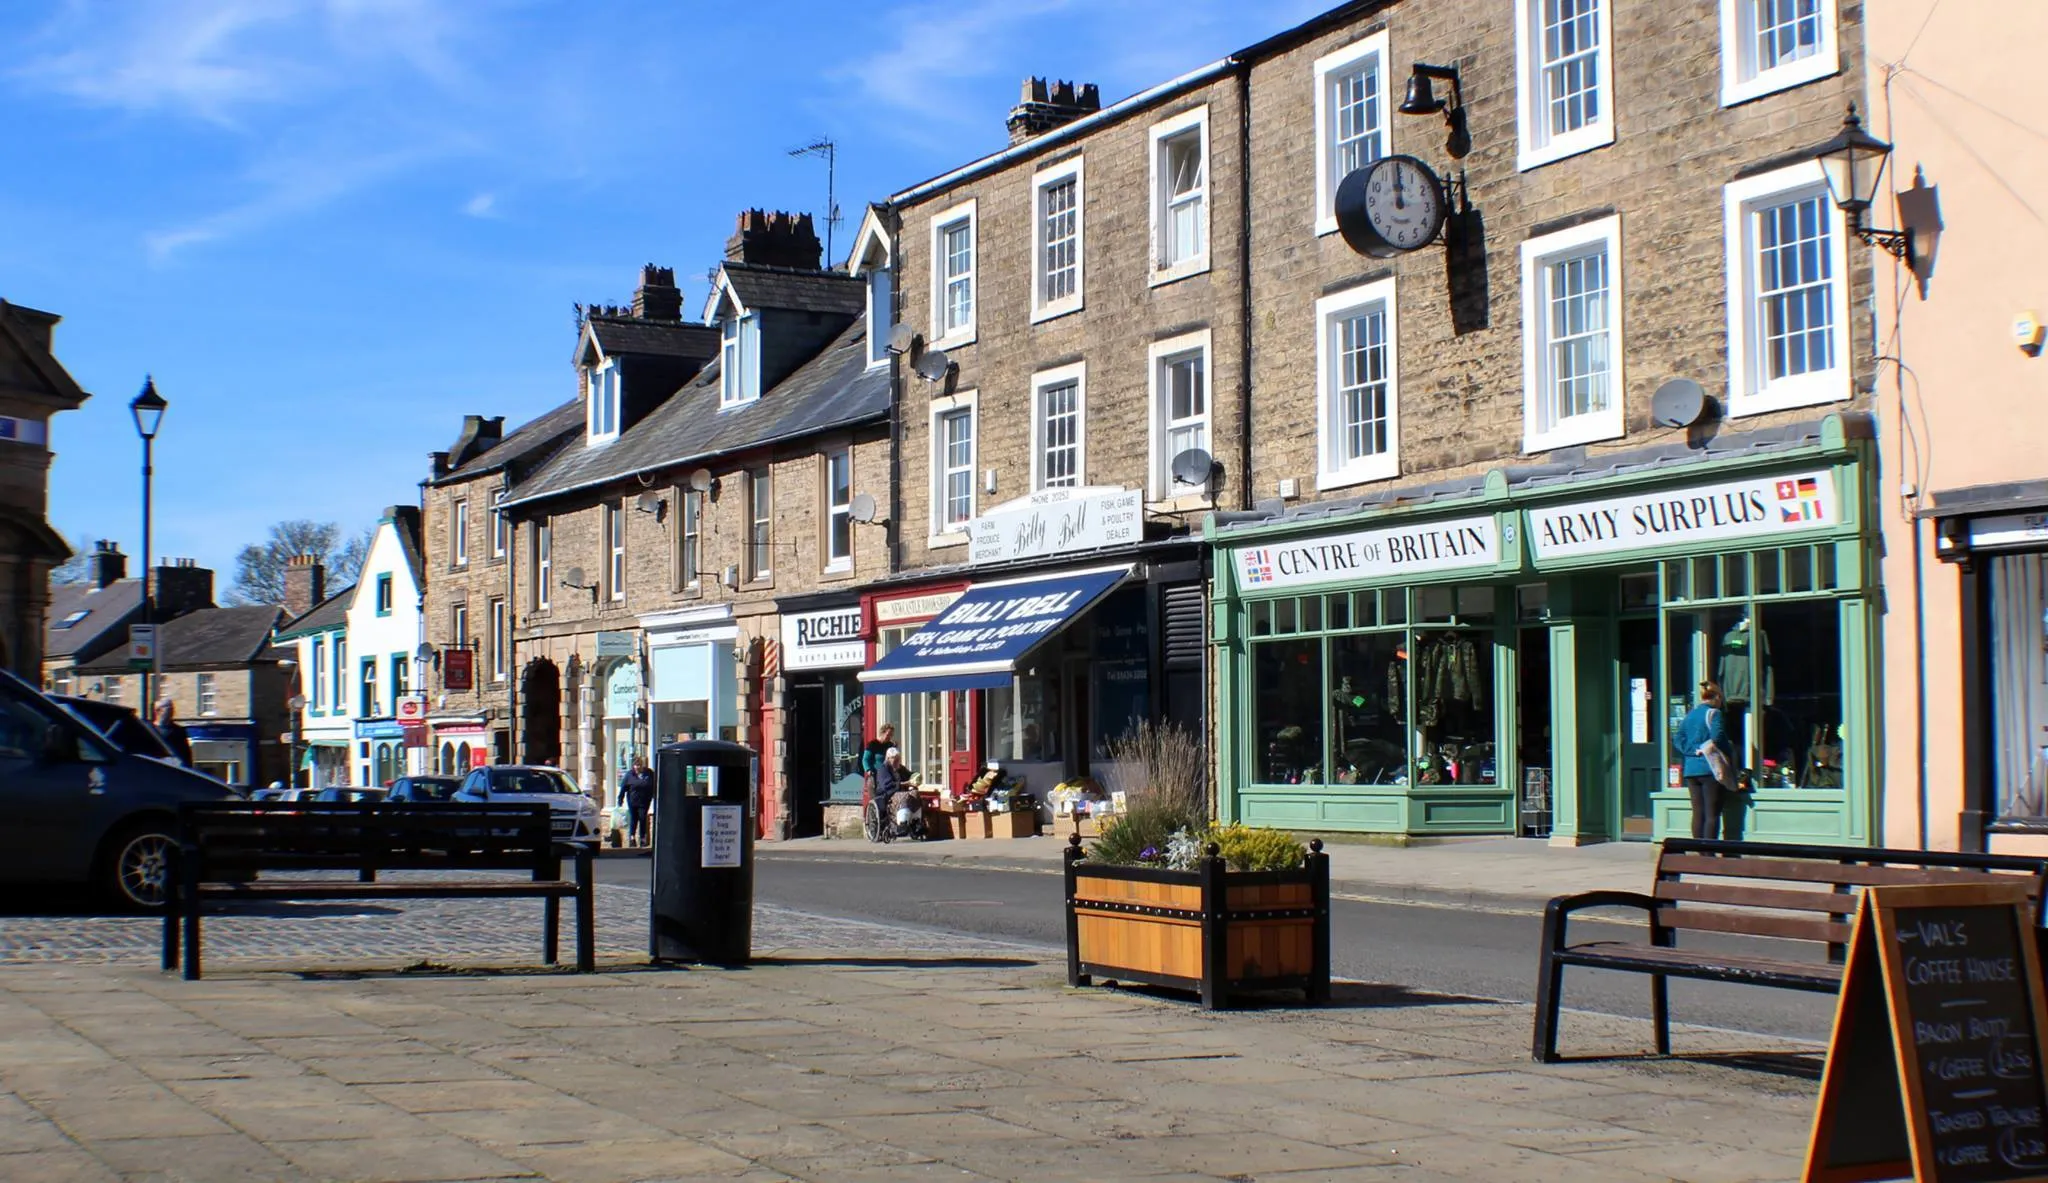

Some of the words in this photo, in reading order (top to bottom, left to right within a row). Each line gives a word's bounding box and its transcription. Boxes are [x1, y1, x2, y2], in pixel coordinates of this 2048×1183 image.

[1420, 185, 1425, 196] 2
[1368, 196, 1376, 207] 9
[1424, 202, 1430, 213] 3
[1374, 213, 1381, 225] 8
[1421, 217, 1428, 229] 4
[1385, 225, 1392, 236] 7
[1398, 231, 1405, 242] 6
[1412, 227, 1419, 239] 5
[1032, 495, 1049, 504] PHONE
[1116, 496, 1135, 508] GAME
[1107, 512, 1134, 526] POULTRY
[1542, 508, 1619, 547] ARMY
[1631, 489, 1767, 536] SURPLUS
[981, 520, 996, 530] FARM
[1013, 511, 1046, 555] Billy
[1058, 500, 1087, 549] Bell
[976, 534, 1000, 545] PRODUCE
[1106, 528, 1130, 540] DEALER
[975, 547, 1001, 560] MERCHANT
[1278, 541, 1360, 575] CENTRE
[1363, 542, 1382, 562] OF
[1386, 526, 1487, 564] BRITAIN
[938, 600, 1017, 626] BILLY
[1004, 590, 1082, 621] BELL
[936, 628, 984, 645] GAME
[988, 618, 1063, 640] POULTRY
[1917, 920, 1968, 948] VAL'S
[1906, 956, 1963, 986] COFFEE
[1966, 957, 2018, 982] HOUSE
[1915, 1021, 1962, 1046] BACON
[1968, 1016, 2010, 1040] BUTTY
[1938, 1056, 1987, 1080] COFFEE
[1948, 1144, 1992, 1166] COFFEE
